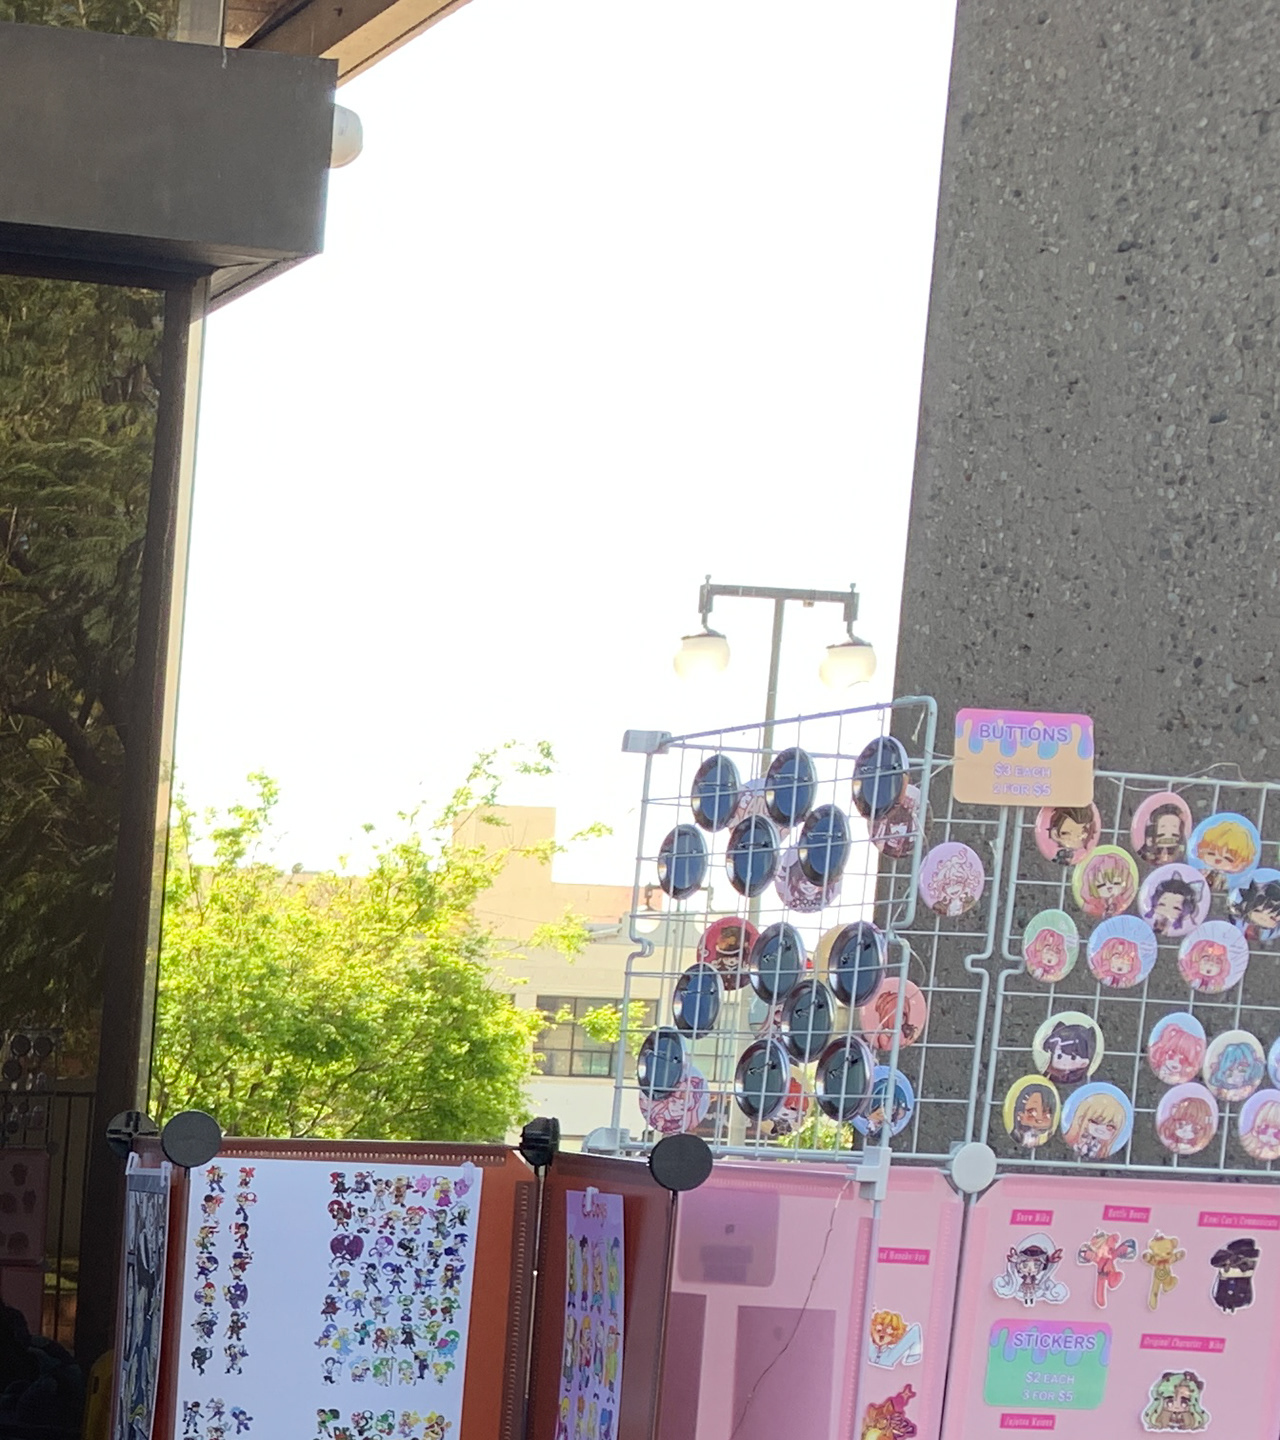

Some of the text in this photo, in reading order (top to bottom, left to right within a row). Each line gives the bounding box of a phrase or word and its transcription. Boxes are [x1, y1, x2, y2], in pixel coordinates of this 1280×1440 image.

[980, 724, 1068, 742] BUTTONS
[995, 762, 1051, 778] $3 EACH
[993, 784, 1051, 798] 2 FOR $5
[1014, 1333, 1096, 1350] STICKERS
[1026, 1372, 1074, 1384] $2 EACH
[1023, 1390, 1073, 1402] 3 FOR $5
